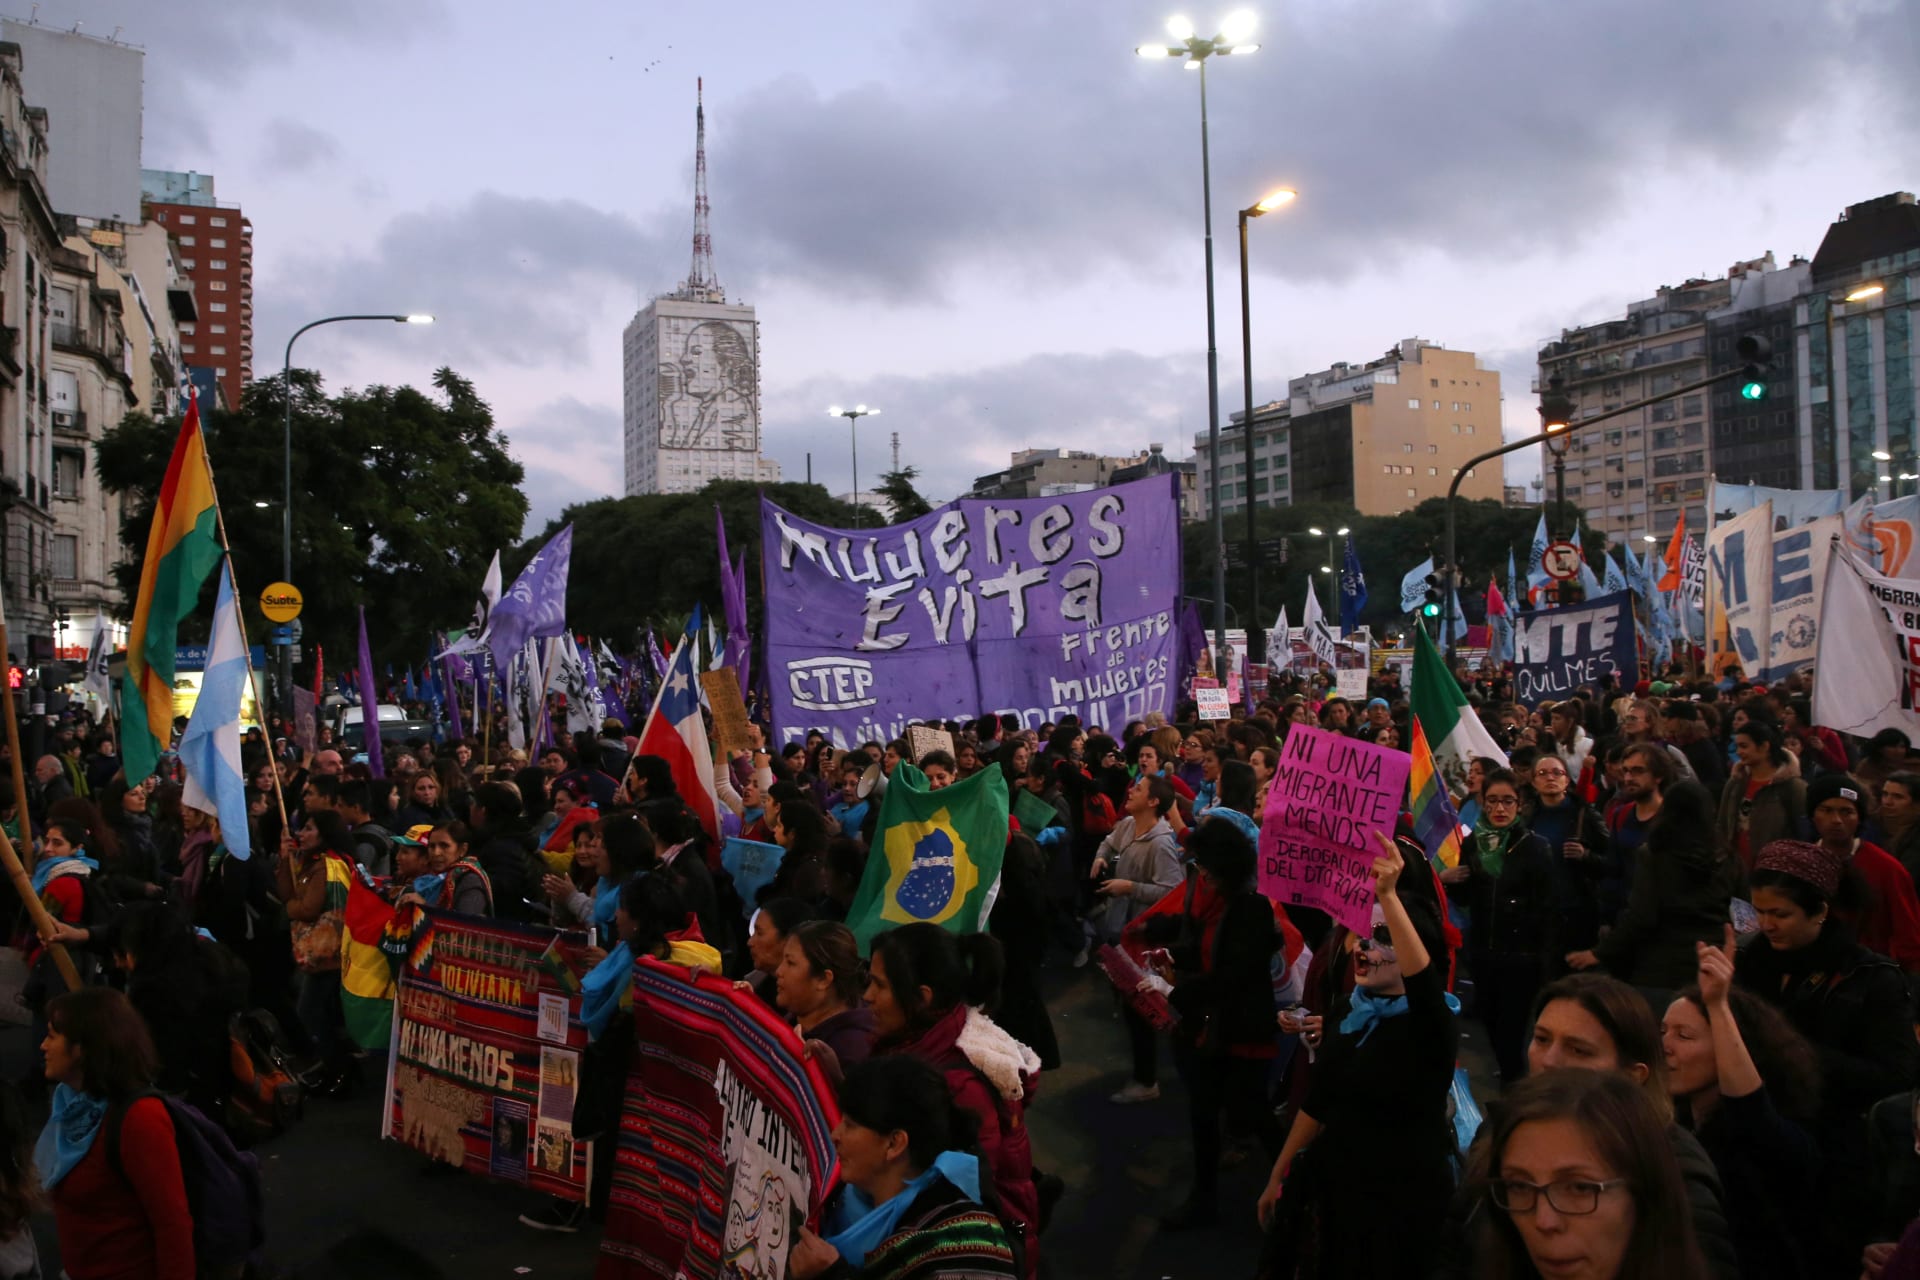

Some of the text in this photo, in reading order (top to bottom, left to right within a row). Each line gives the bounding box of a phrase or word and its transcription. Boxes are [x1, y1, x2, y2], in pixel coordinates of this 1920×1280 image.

[1106, 648, 1124, 668] de
[1514, 604, 1620, 664] MTE
[789, 665, 875, 702] CTEP
[1289, 731, 1382, 787] NI UNA
[1274, 764, 1391, 824] MIGRANTE
[1285, 803, 1368, 851] MENOS
[1266, 857, 1297, 880] DEL
[1304, 865, 1334, 888] DTO
[1277, 839, 1372, 883] DEROGACION
[400, 1018, 515, 1092] NI UNA MENOS
